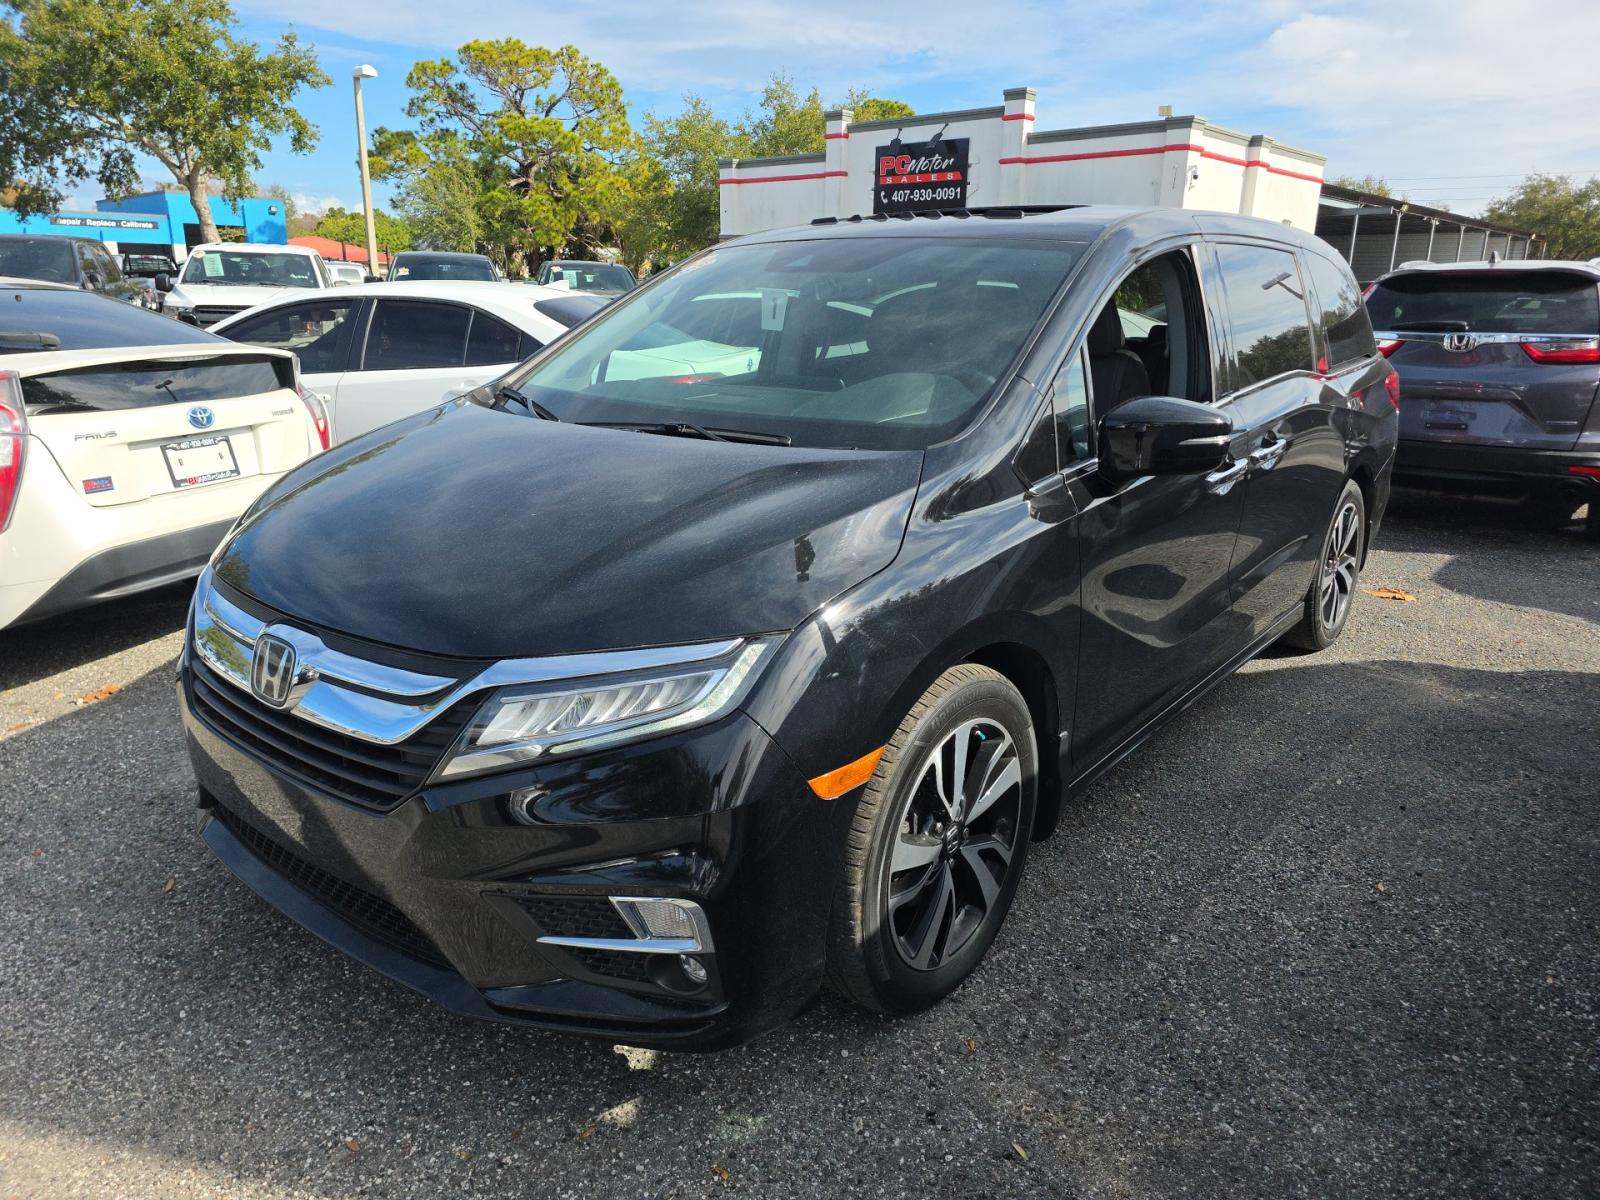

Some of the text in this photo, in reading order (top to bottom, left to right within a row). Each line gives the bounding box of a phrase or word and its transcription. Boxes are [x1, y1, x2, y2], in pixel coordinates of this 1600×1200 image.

[880, 153, 955, 176] PC Motor
[886, 173, 954, 184] SALES
[891, 187, 961, 202] 407-930-0091
[86, 218, 117, 228] Replace
[120, 220, 154, 229] Calibrate
[74, 431, 117, 442] PRIUS
